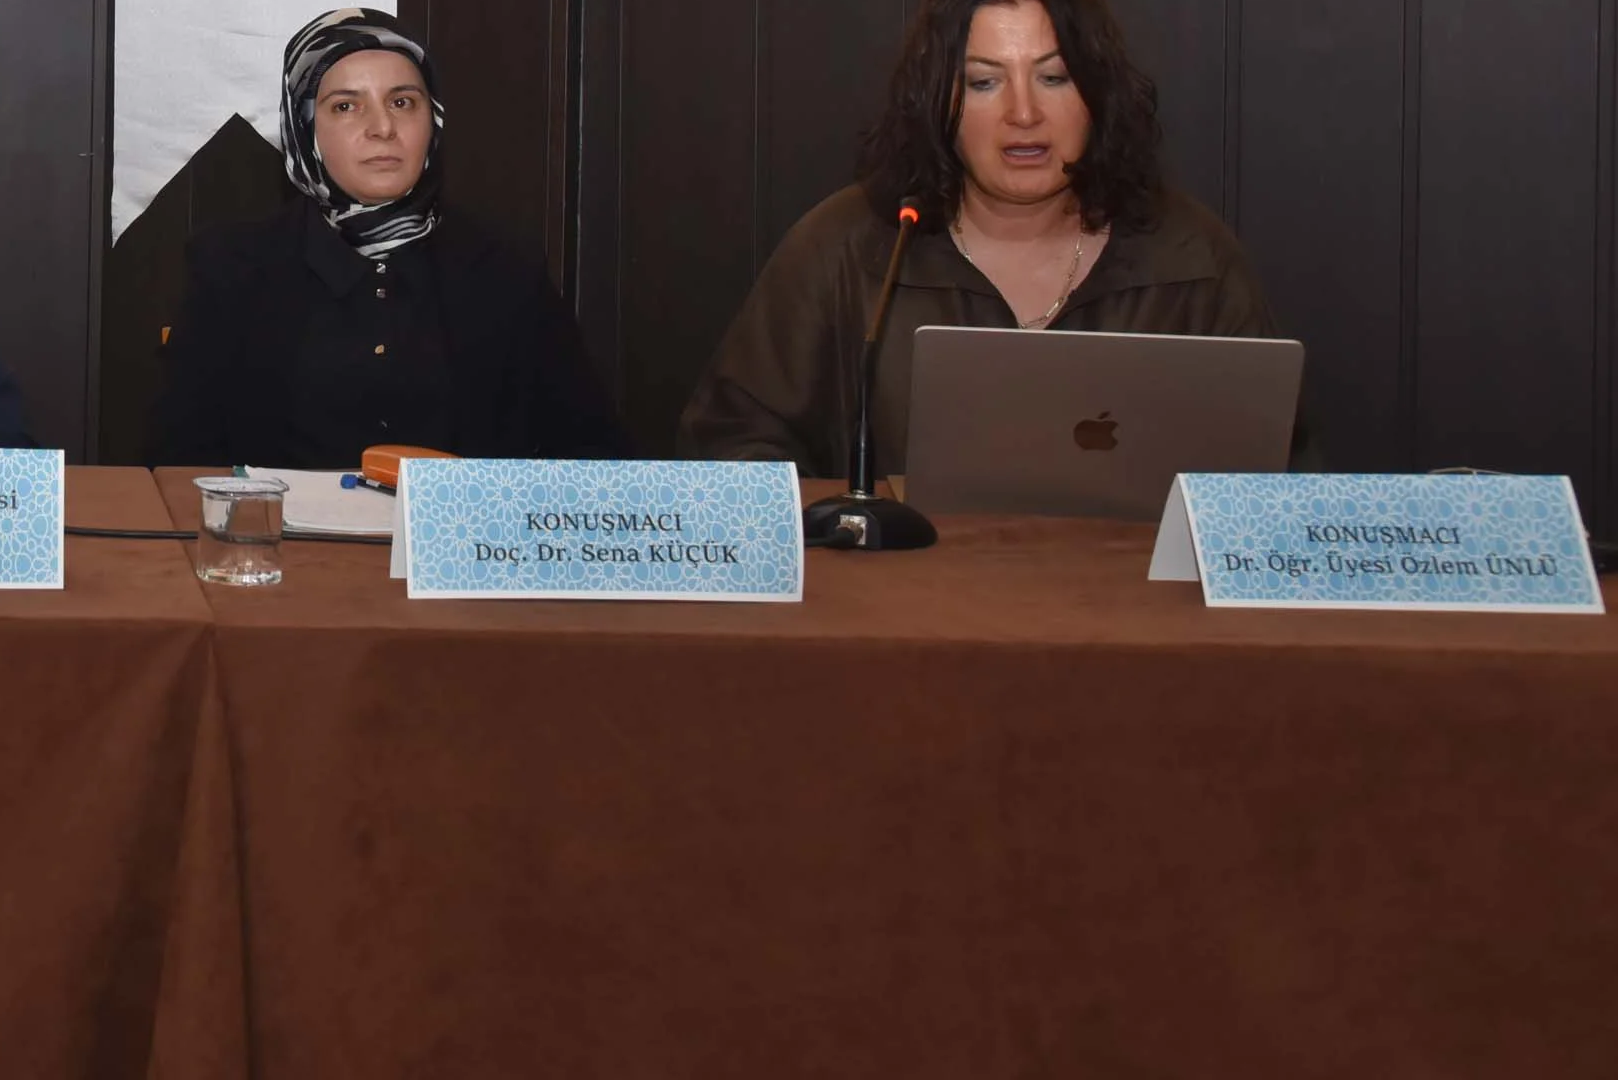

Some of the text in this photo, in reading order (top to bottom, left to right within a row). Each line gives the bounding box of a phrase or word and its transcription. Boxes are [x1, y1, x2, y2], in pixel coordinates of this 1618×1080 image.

[526, 512, 683, 536] KONUŞMACI
[1307, 525, 1460, 548] KONUŞMACI
[475, 542, 739, 569] Doç. Dr. Sena KÜÇÜK
[1224, 553, 1260, 572] Dr.
[1269, 550, 1319, 578] Öğr.
[1328, 551, 1392, 578] Üyesi
[1401, 552, 1479, 575] Özlem
